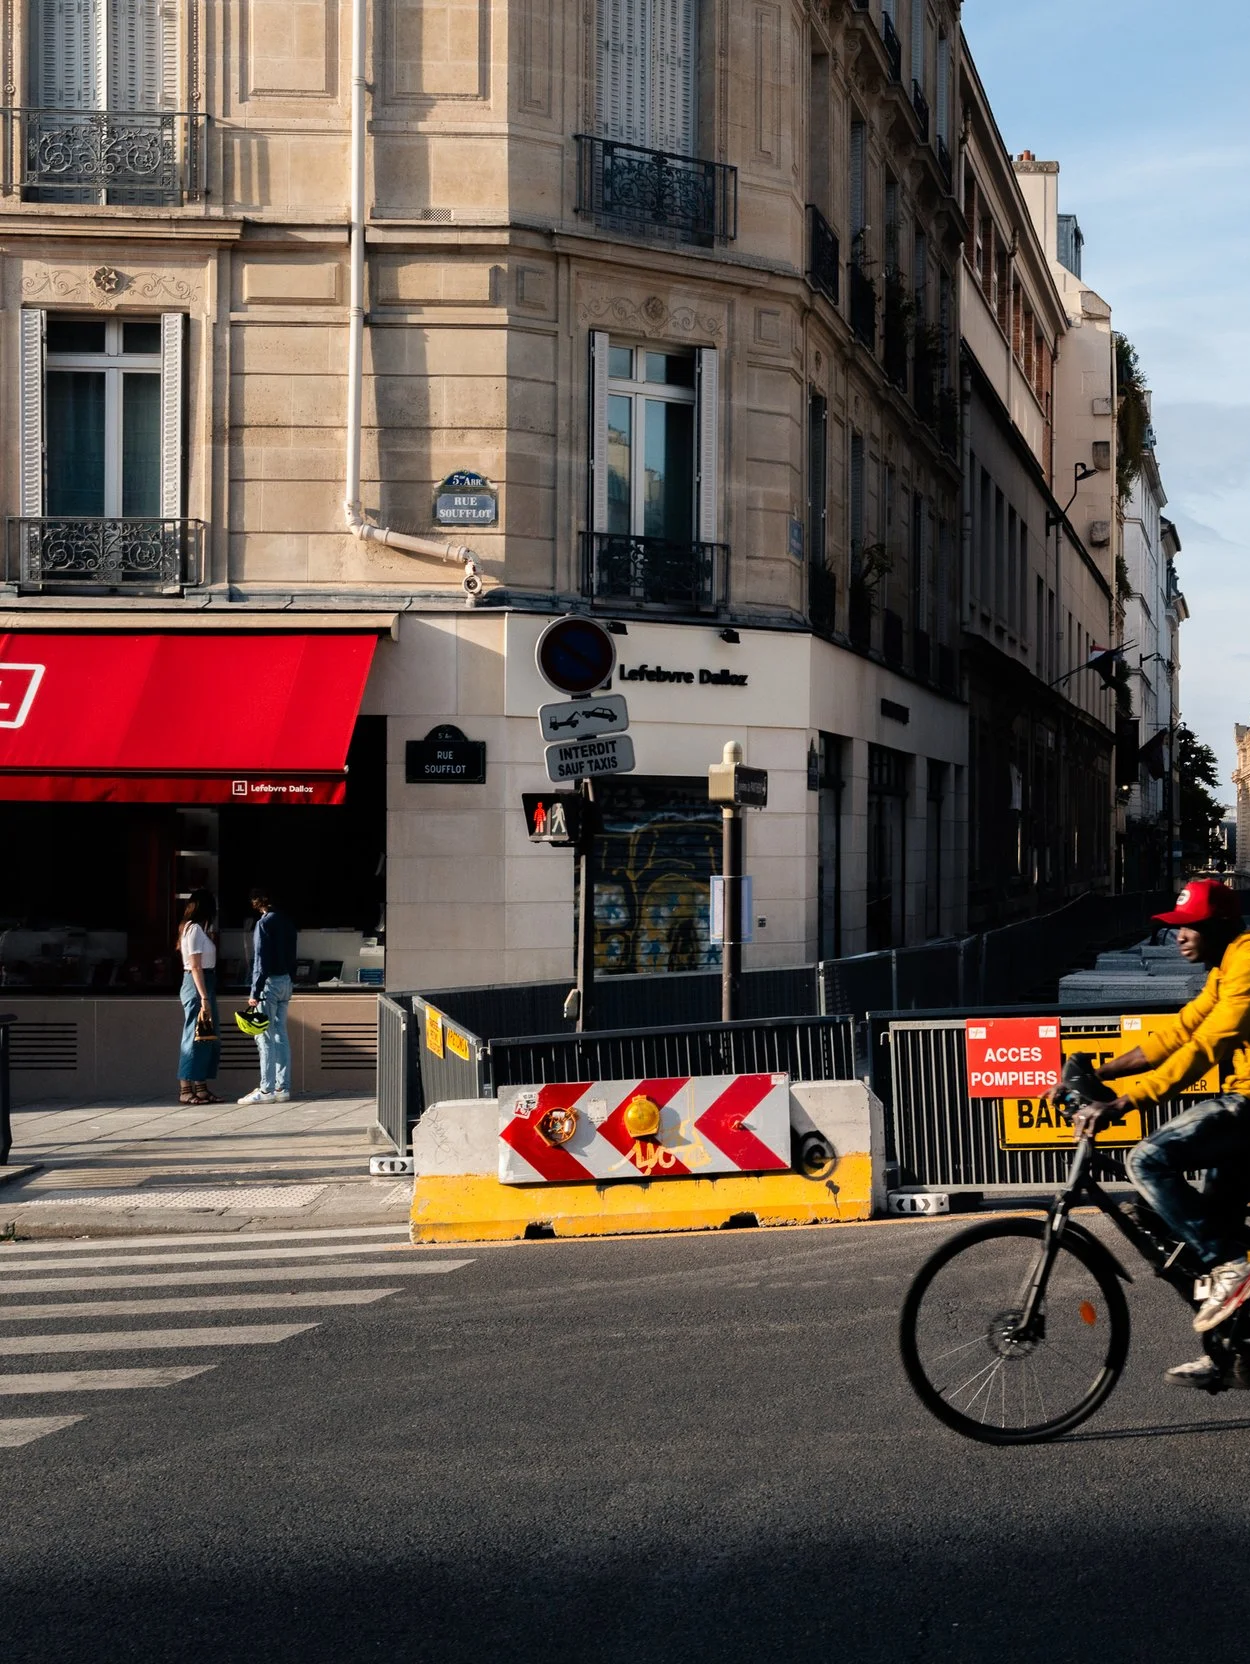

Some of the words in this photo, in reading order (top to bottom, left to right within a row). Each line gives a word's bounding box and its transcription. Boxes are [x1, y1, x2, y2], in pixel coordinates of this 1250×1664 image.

[454, 496, 478, 506] RUE
[439, 509, 491, 518] SOUFFLOT
[619, 664, 695, 684] Lefebvre
[699, 669, 748, 686] Dalloz
[437, 751, 454, 760] RUE
[559, 740, 617, 761] INTERDIT
[424, 764, 466, 774] SOUFFLOT
[558, 760, 585, 777] SAUF
[588, 756, 618, 773] TAXIS
[250, 784, 287, 792] Lefebvre
[288, 785, 314, 793] Dalloz
[984, 1047, 1042, 1062] ACCES
[971, 1071, 1058, 1087] POMPIERS
